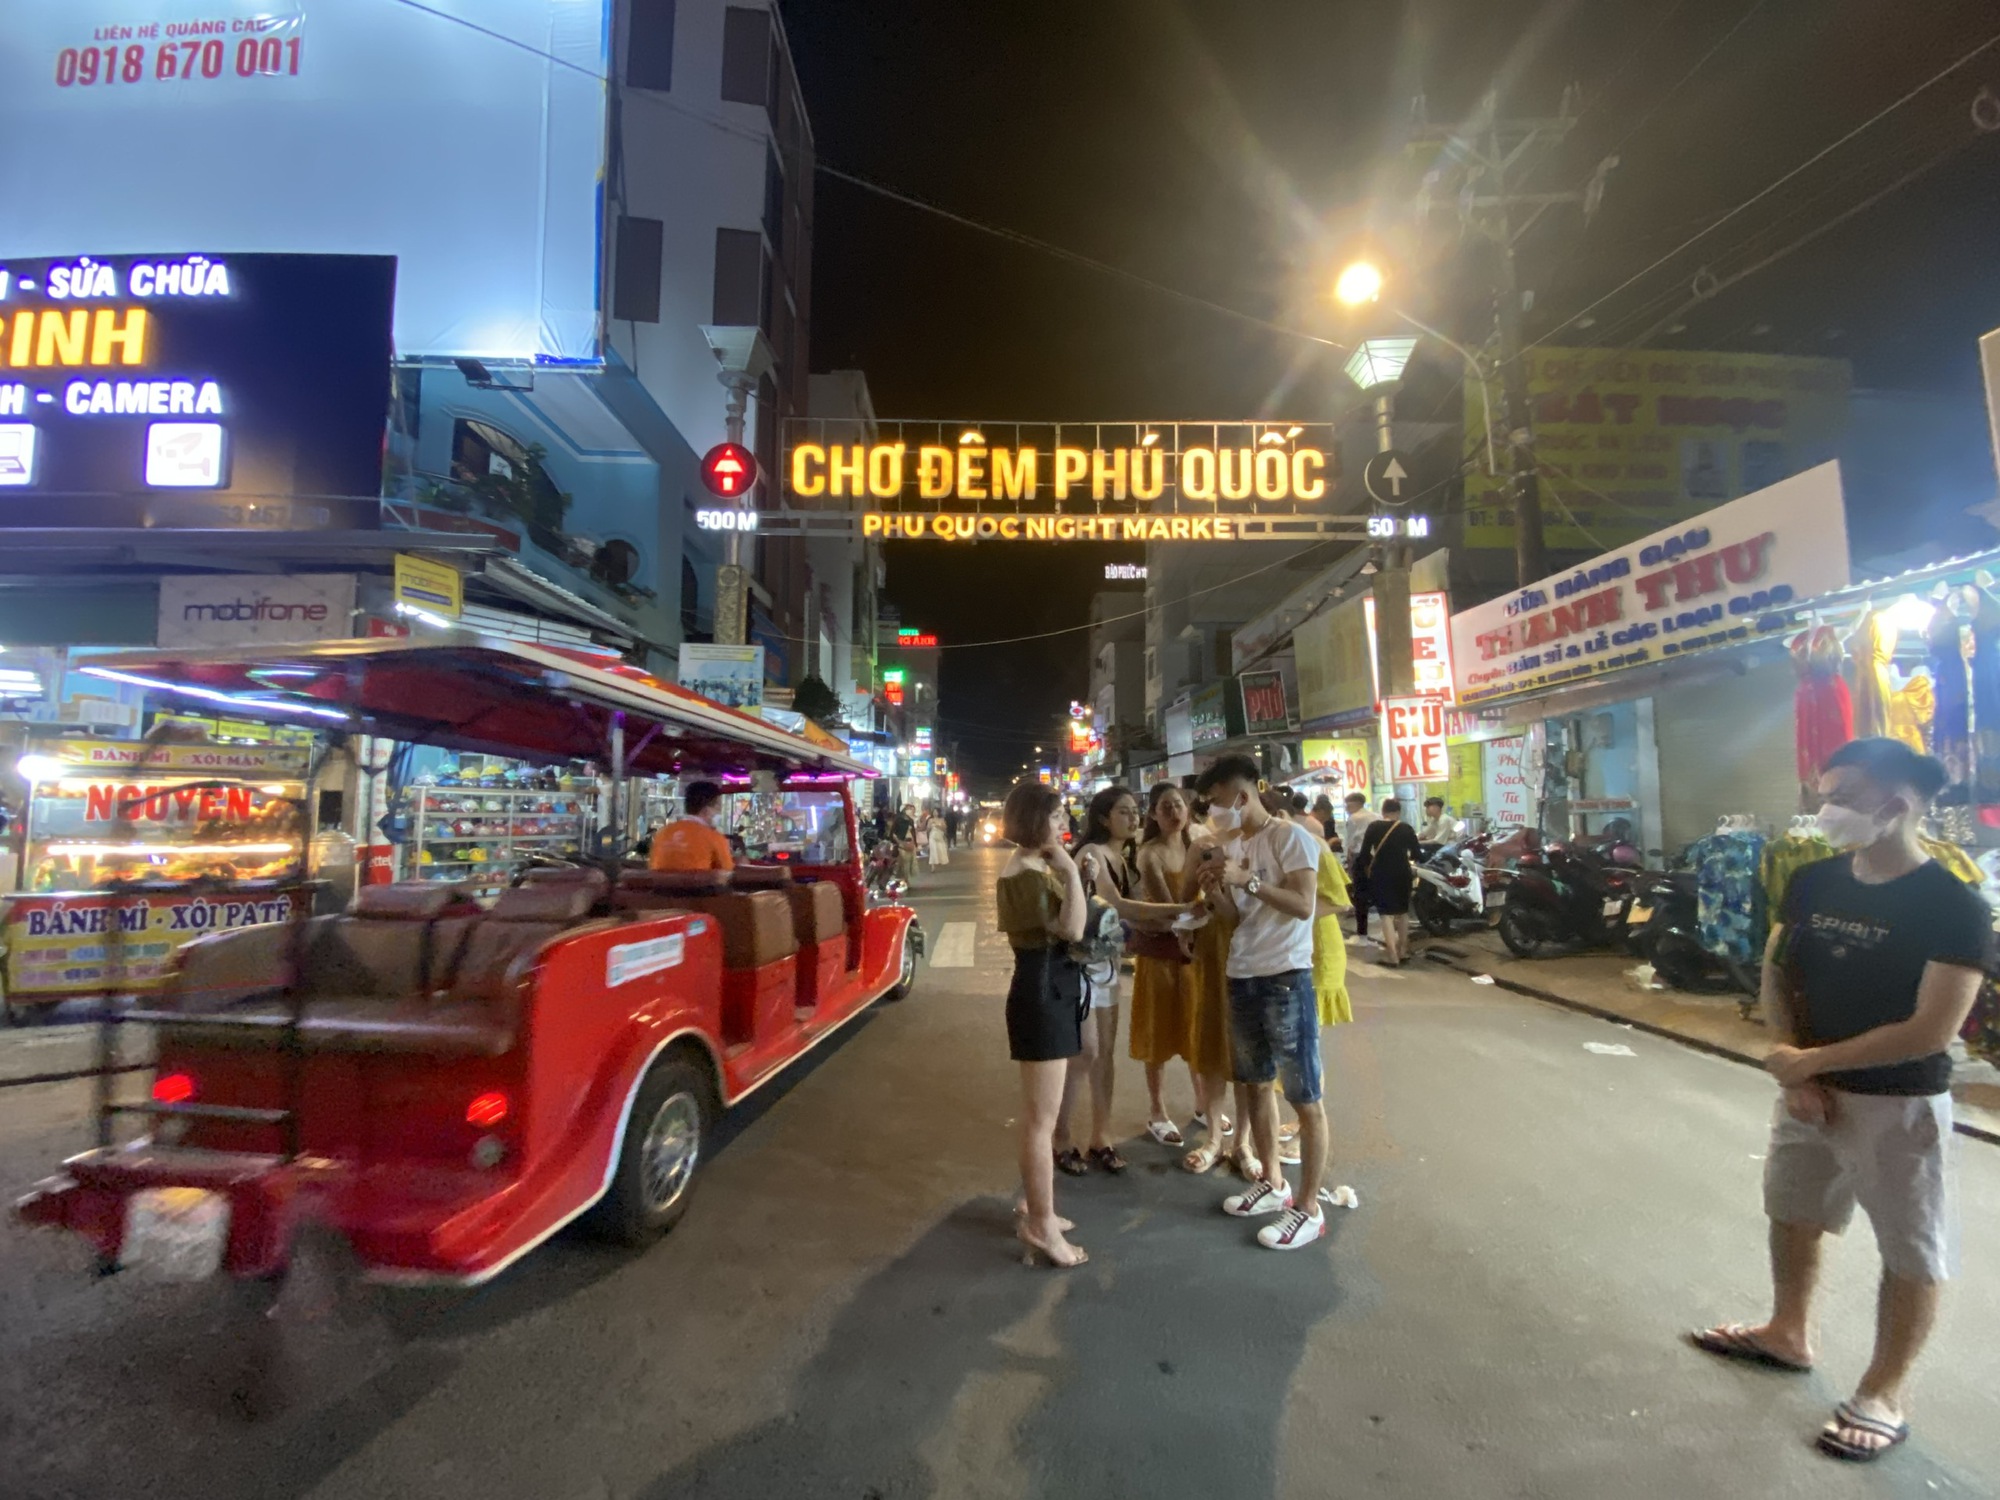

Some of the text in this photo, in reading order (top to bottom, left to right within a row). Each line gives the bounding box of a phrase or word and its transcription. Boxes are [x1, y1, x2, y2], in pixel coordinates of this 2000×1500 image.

[94, 24, 133, 41] LIÊN
[55, 36, 301, 88] 0918 670 001
[47, 256, 116, 299] SỬA
[129, 254, 230, 297] CHỮA
[65, 380, 223, 415] CAMERA
[916, 430, 1037, 500] ĐÊM
[1054, 432, 1164, 501] PHÚ
[1181, 426, 1326, 503] QUỐC
[863, 513, 926, 538] PHU
[932, 514, 1020, 541] QUOC
[1025, 515, 1116, 540] NIGHT
[183, 595, 328, 622] mobifone
[1475, 584, 1624, 661] THANH
[1387, 697, 1443, 740] GIỮ
[1396, 743, 1444, 777] XE
[170, 898, 218, 930] XÔI
